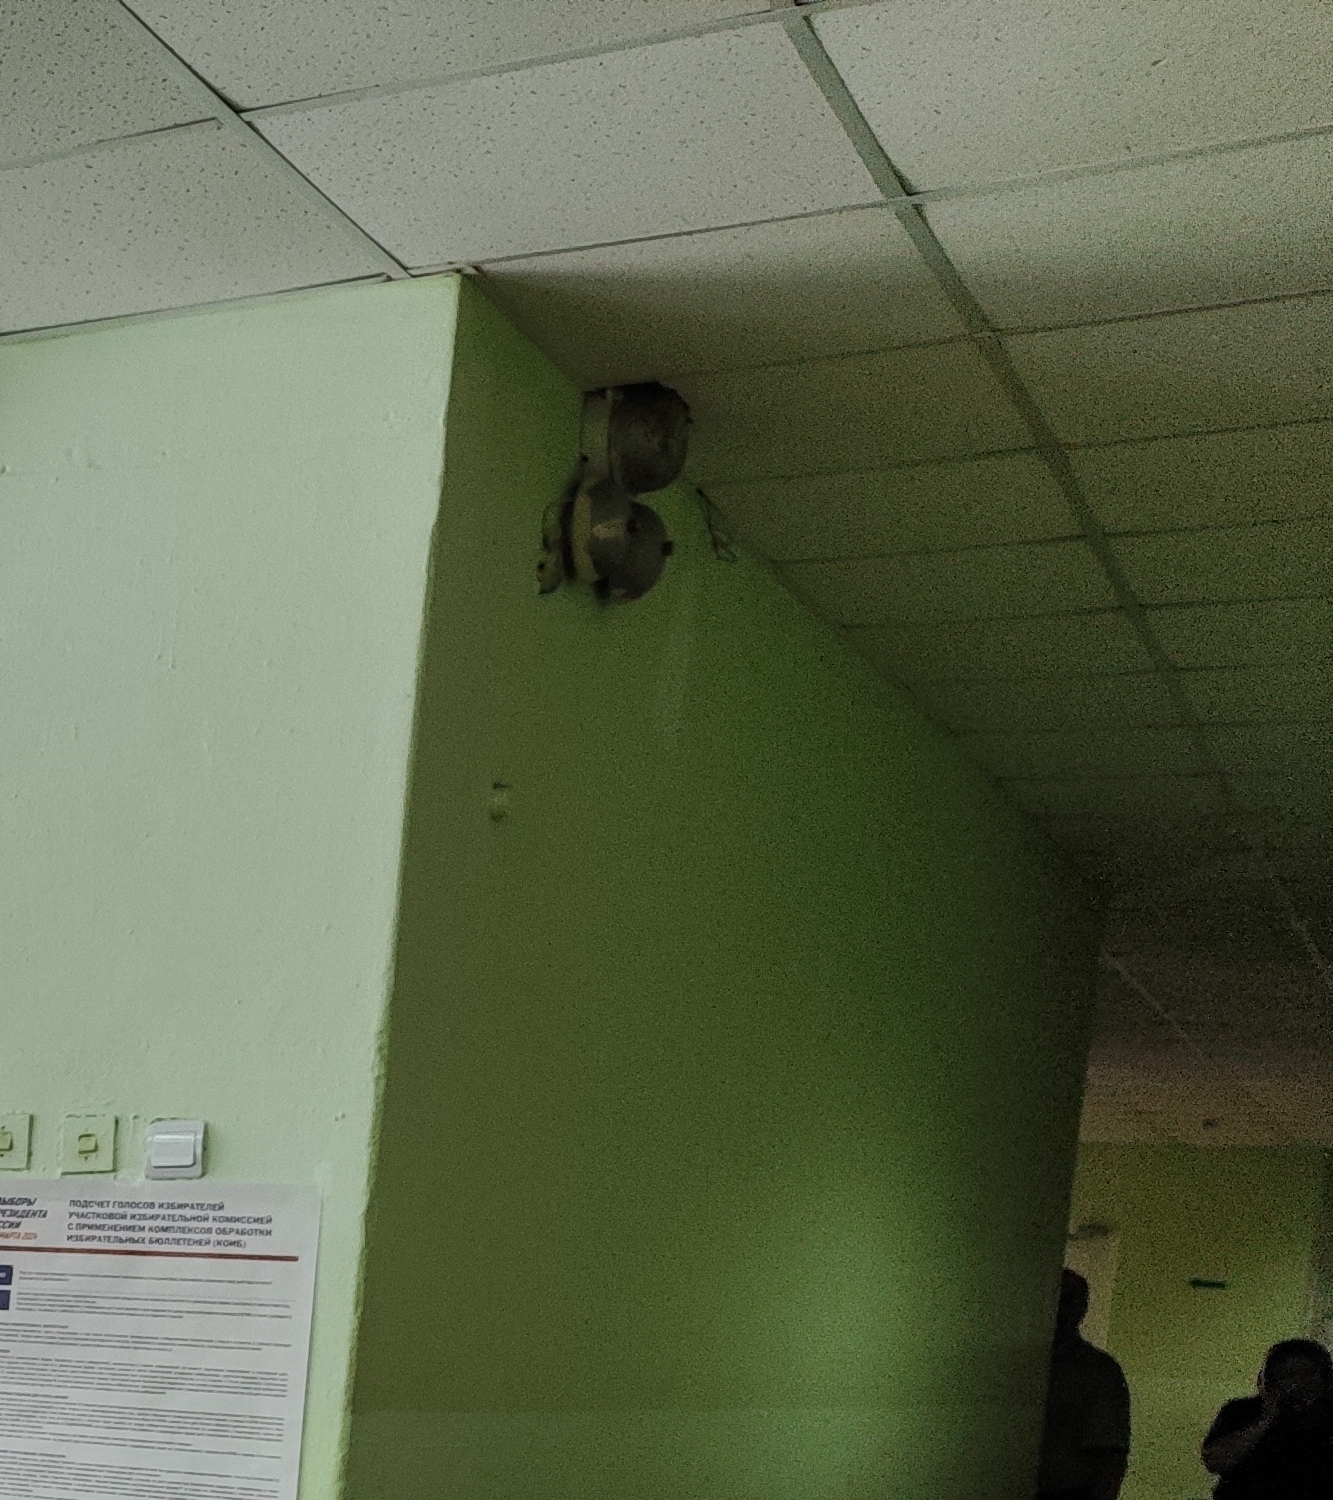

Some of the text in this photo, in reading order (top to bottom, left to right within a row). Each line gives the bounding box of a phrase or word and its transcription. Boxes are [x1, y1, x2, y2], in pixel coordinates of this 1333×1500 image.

[69, 1200, 225, 1212] ПОДСЧЕТ ГОЛОСОВ ИЗБИРАТЕЛЕЙ
[68, 1210, 273, 1225] УЧАСТКОВОЙ ИЗБИРАТЕЛЬНОЙ КОМИССИЕЙ
[67, 1223, 273, 1237] С ПРИМЕНЕНИЕМ КОМПЛЕКСОВ ОБРАБОТКИ
[66, 1234, 146, 1245] ИЗБИРАТЕЛЬНЫХ
[148, 1236, 212, 1247] БЮЛЛЕТЕНЕЙ
